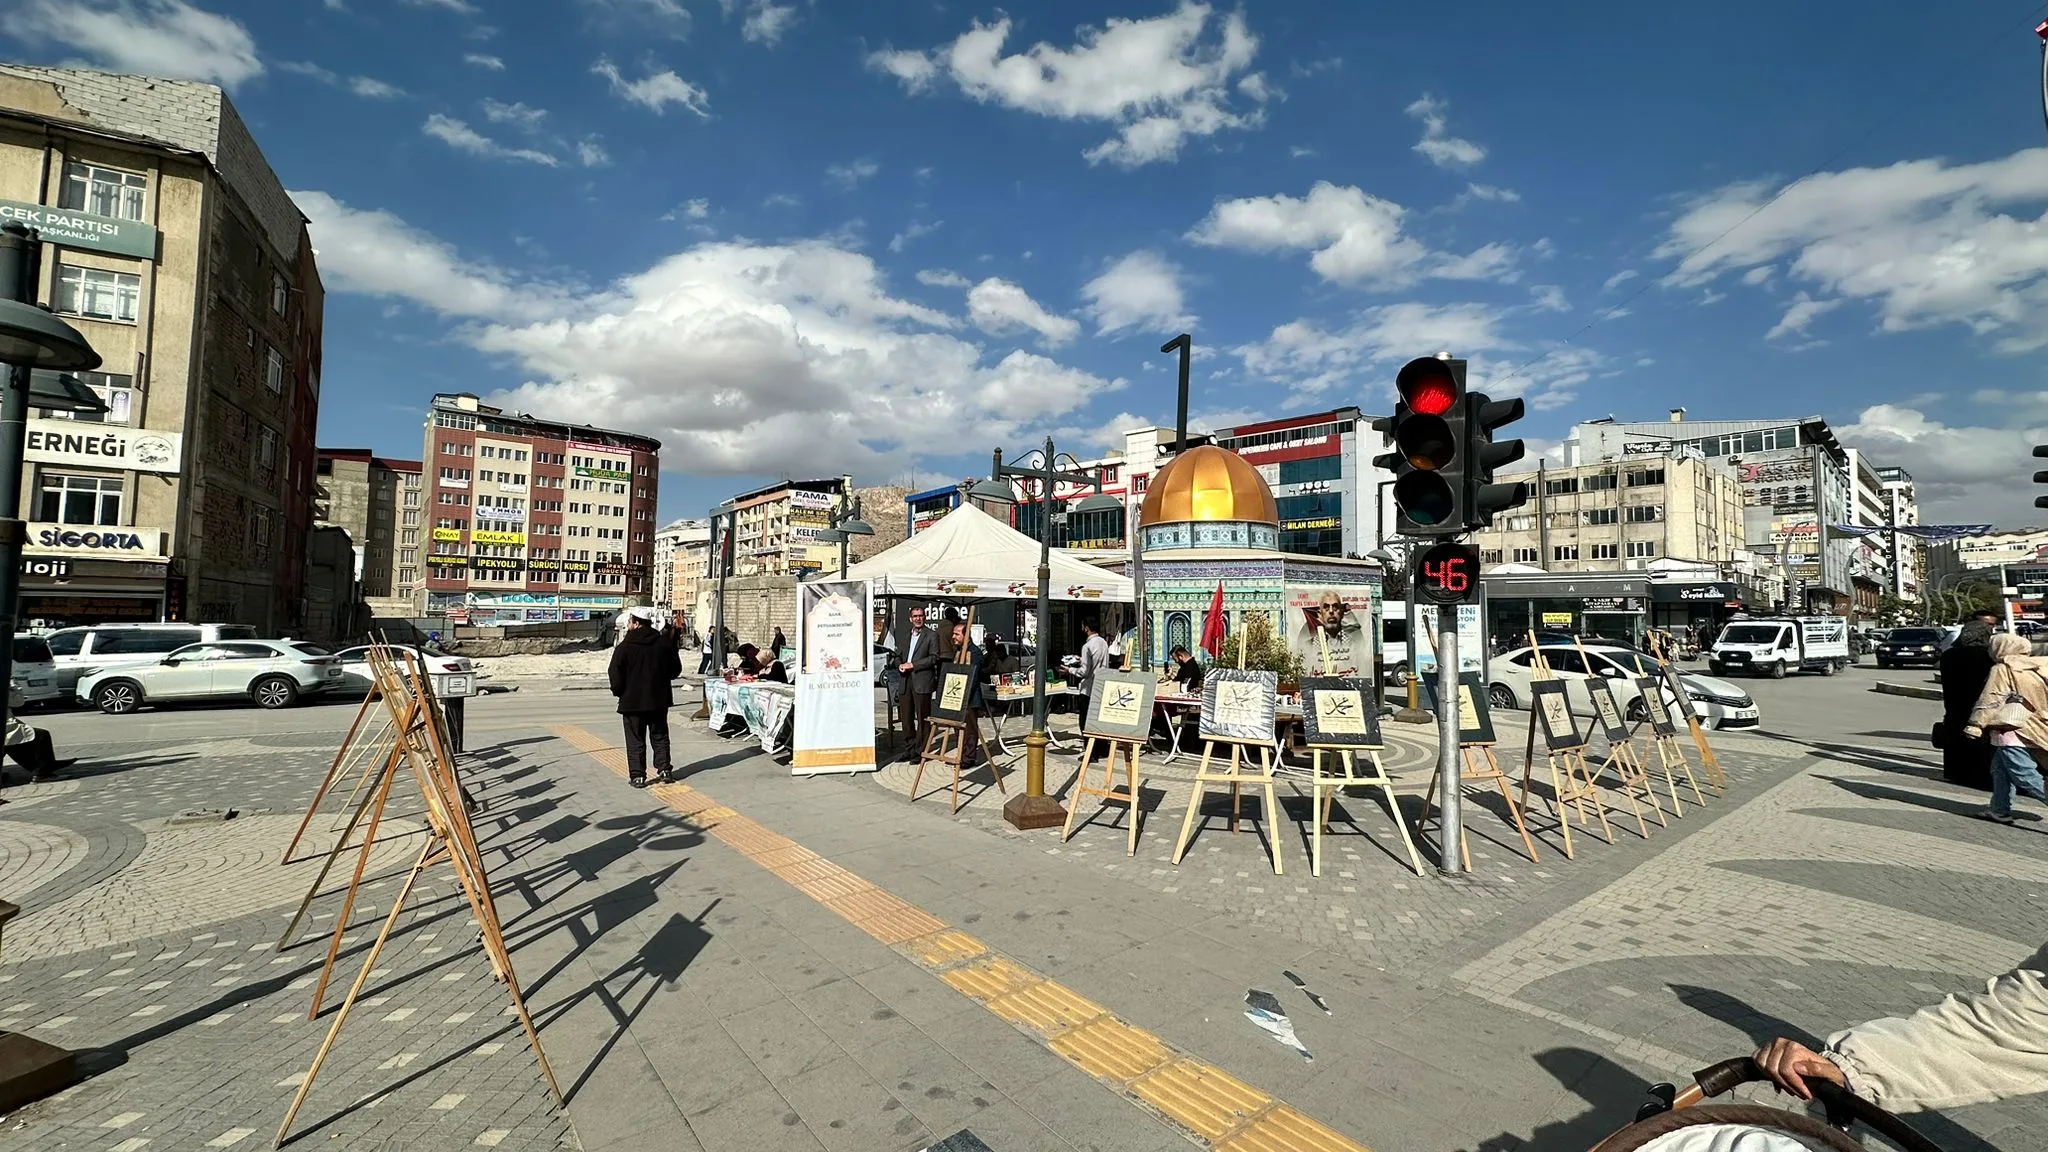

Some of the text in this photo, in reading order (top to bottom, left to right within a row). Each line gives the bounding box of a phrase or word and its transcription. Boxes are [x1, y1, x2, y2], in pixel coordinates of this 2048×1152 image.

[795, 491, 828, 501] FAMA
[476, 533, 514, 542] EMLAK
[20, 560, 66, 577] loji
[477, 558, 517, 568] İPEKYOLU
[564, 562, 589, 571] KURSU
[1424, 558, 1468, 591] 46
